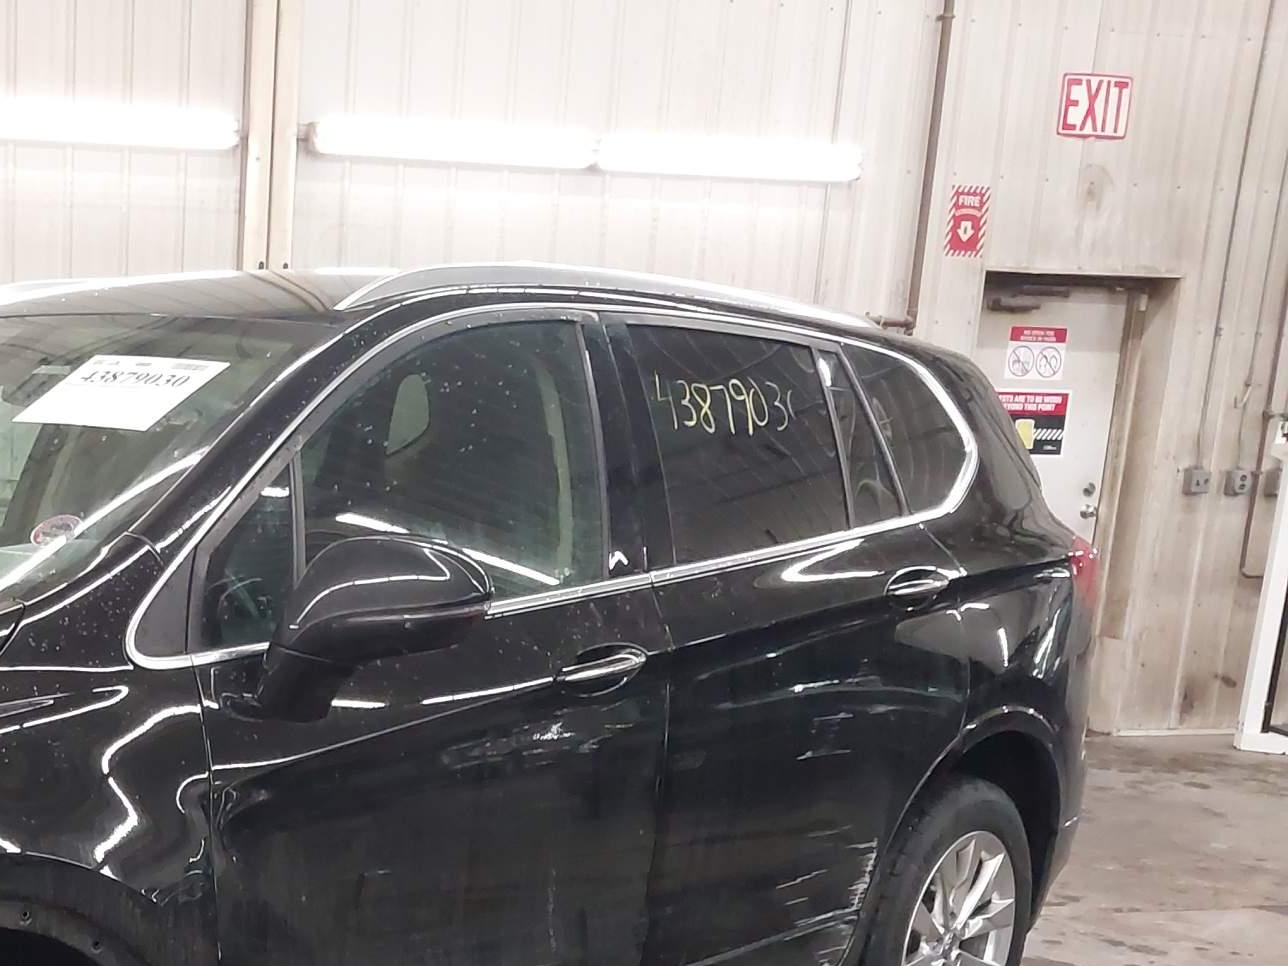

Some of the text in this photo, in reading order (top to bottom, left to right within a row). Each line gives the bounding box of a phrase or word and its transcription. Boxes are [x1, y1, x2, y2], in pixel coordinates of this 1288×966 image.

[1062, 78, 1129, 134] EXIT
[958, 195, 981, 207] FIRE
[80, 370, 191, 388] 43879030
